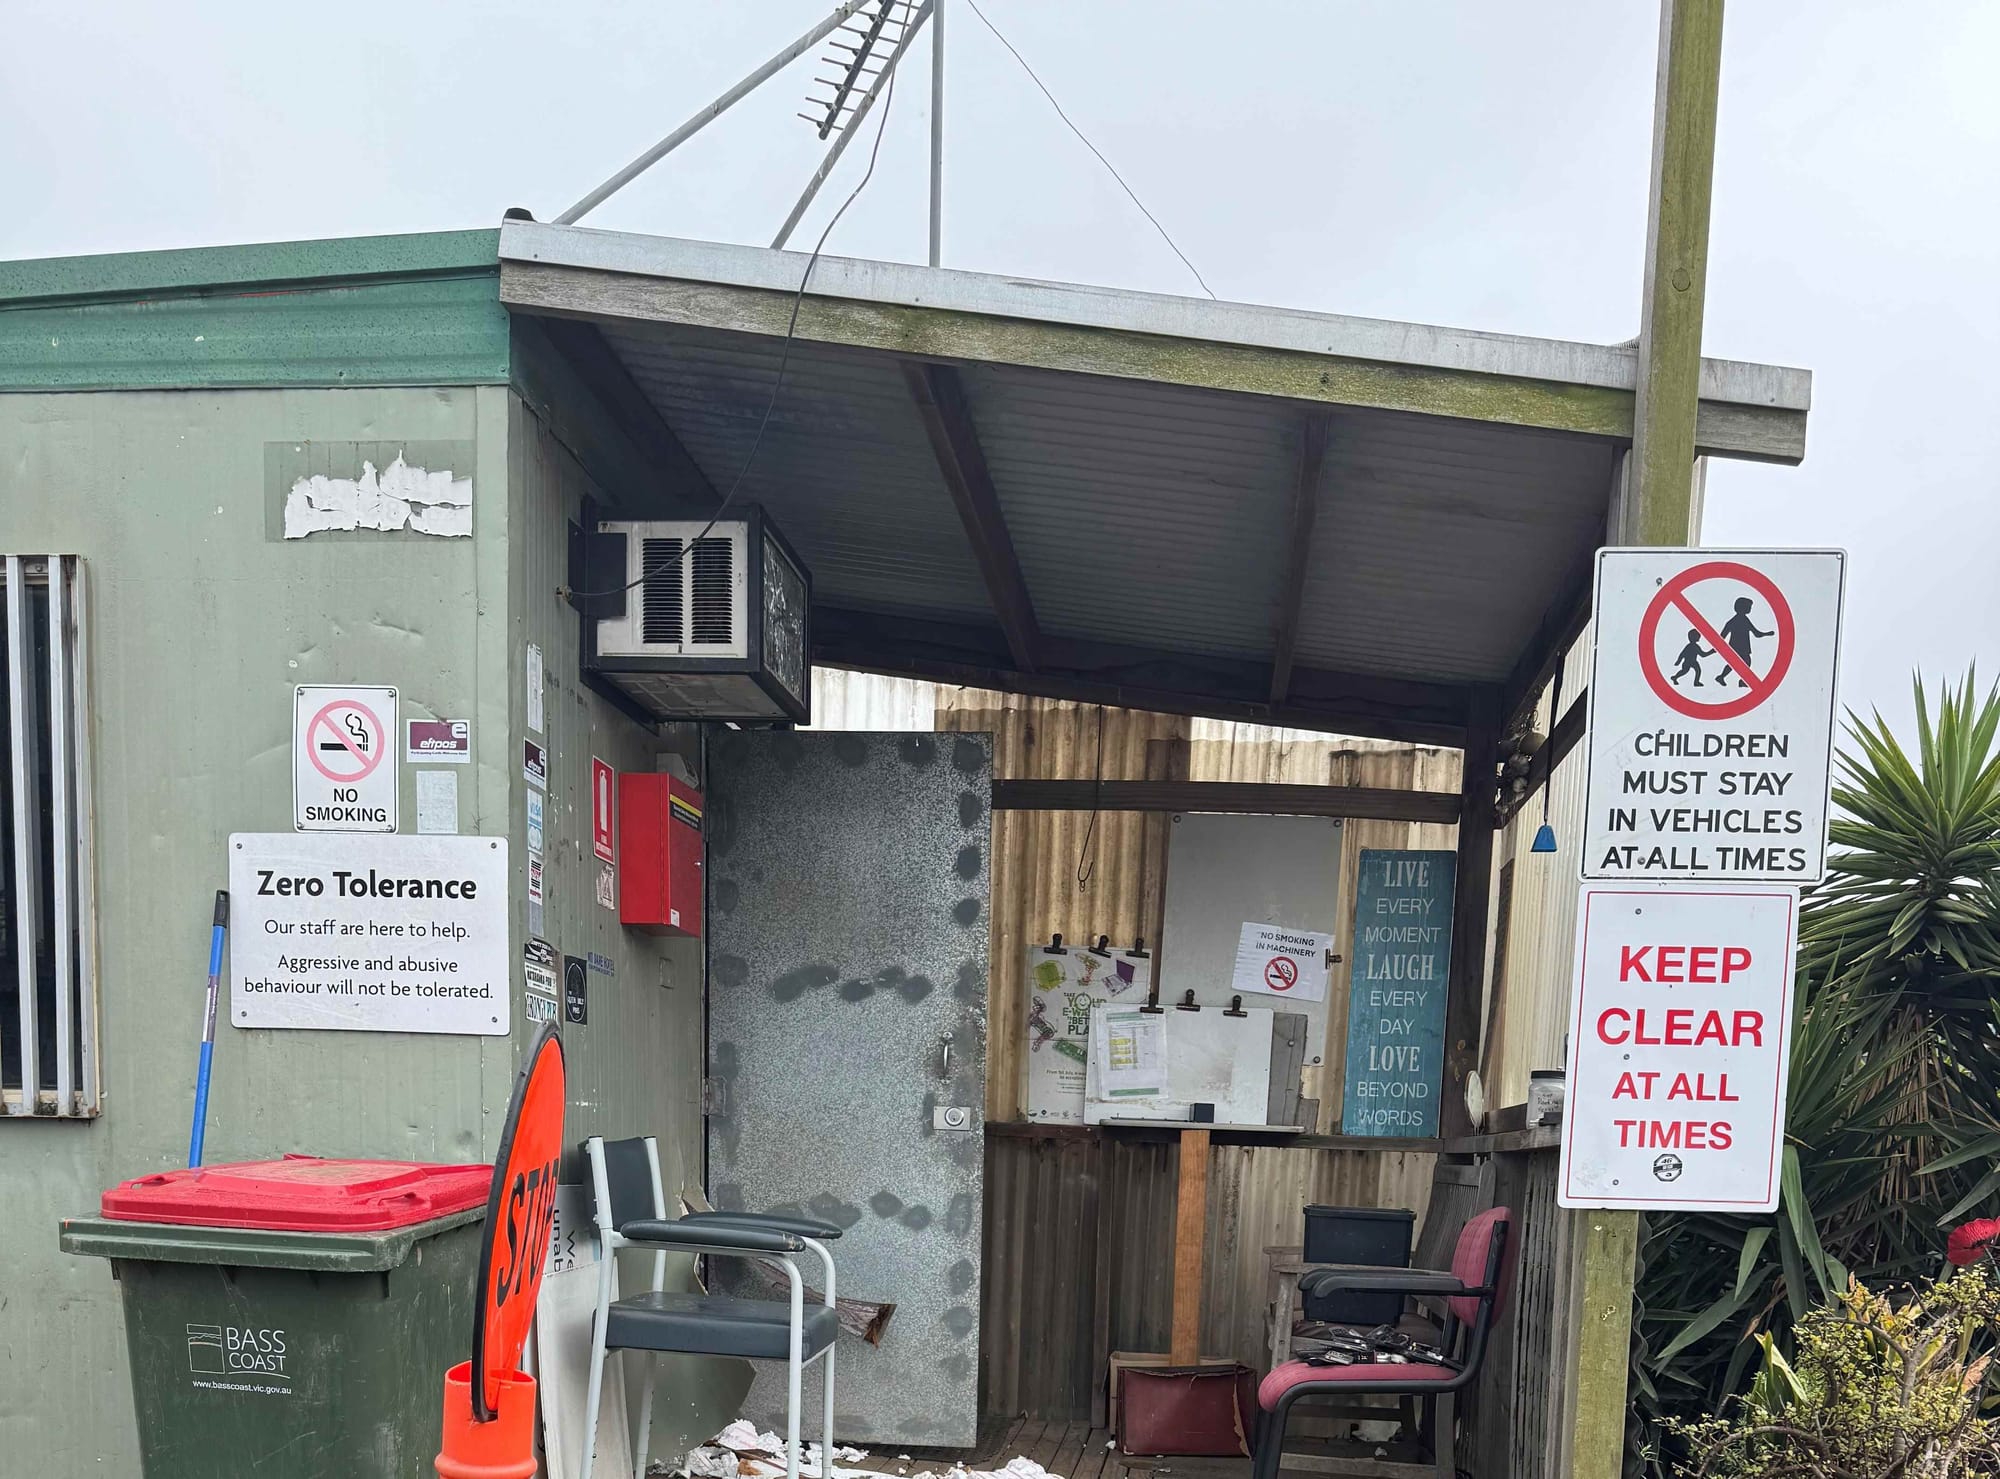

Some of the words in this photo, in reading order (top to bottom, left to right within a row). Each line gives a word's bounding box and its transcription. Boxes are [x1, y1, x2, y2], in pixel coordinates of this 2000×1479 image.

[420, 738, 458, 751] eftpos
[1634, 733, 1789, 758] CHILDREN
[1623, 770, 1708, 795] MUST
[1718, 772, 1794, 796] STAY
[333, 788, 358, 803] NO
[306, 806, 387, 823] SMOKING
[1608, 808, 1637, 832] IN
[1650, 808, 1803, 834] VEHICLES
[1600, 846, 1639, 870] AT
[1644, 847, 1709, 870] ALL
[1716, 847, 1806, 872] TIMES
[257, 870, 324, 896] Zero
[332, 869, 477, 899] Tolerance
[1384, 861, 1430, 888] LIVE
[1376, 897, 1435, 915] EVERY
[264, 919, 295, 935] Our
[300, 919, 336, 935] staff
[340, 923, 364, 935] are
[369, 920, 404, 936] here
[408, 923, 426, 937] to
[432, 921, 471, 942] help.
[1260, 931, 1274, 940] NO
[1275, 933, 1315, 947] SMOKING
[1365, 926, 1442, 943] MOMENT
[1255, 942, 1266, 950] IN
[1266, 943, 1317, 957] MACHINERY
[277, 954, 359, 973] Aggressive
[364, 955, 393, 971] and
[398, 956, 458, 973] abusive
[1366, 954, 1435, 981] LAUGH
[1619, 945, 1752, 984] KEEP
[244, 977, 322, 994] behaviour
[327, 979, 353, 995] will
[358, 982, 386, 996] not
[391, 980, 411, 996] be
[416, 981, 494, 999] tolerated.
[1370, 990, 1428, 1008] EVERY
[1380, 1018, 1415, 1035] DAY
[1596, 1007, 1764, 1047] CLEAR
[1368, 1045, 1420, 1072] LOVE
[1357, 1081, 1429, 1099] BEYOND
[1611, 1072, 1661, 1101] AT
[1667, 1073, 1740, 1102] ALL
[1358, 1109, 1424, 1126] WORDS
[1613, 1120, 1733, 1150] TIMES
[226, 1327, 286, 1353] BASS
[228, 1352, 287, 1371] COAST
[192, 1380, 292, 1395] www.basscoast.vic.gov.au
